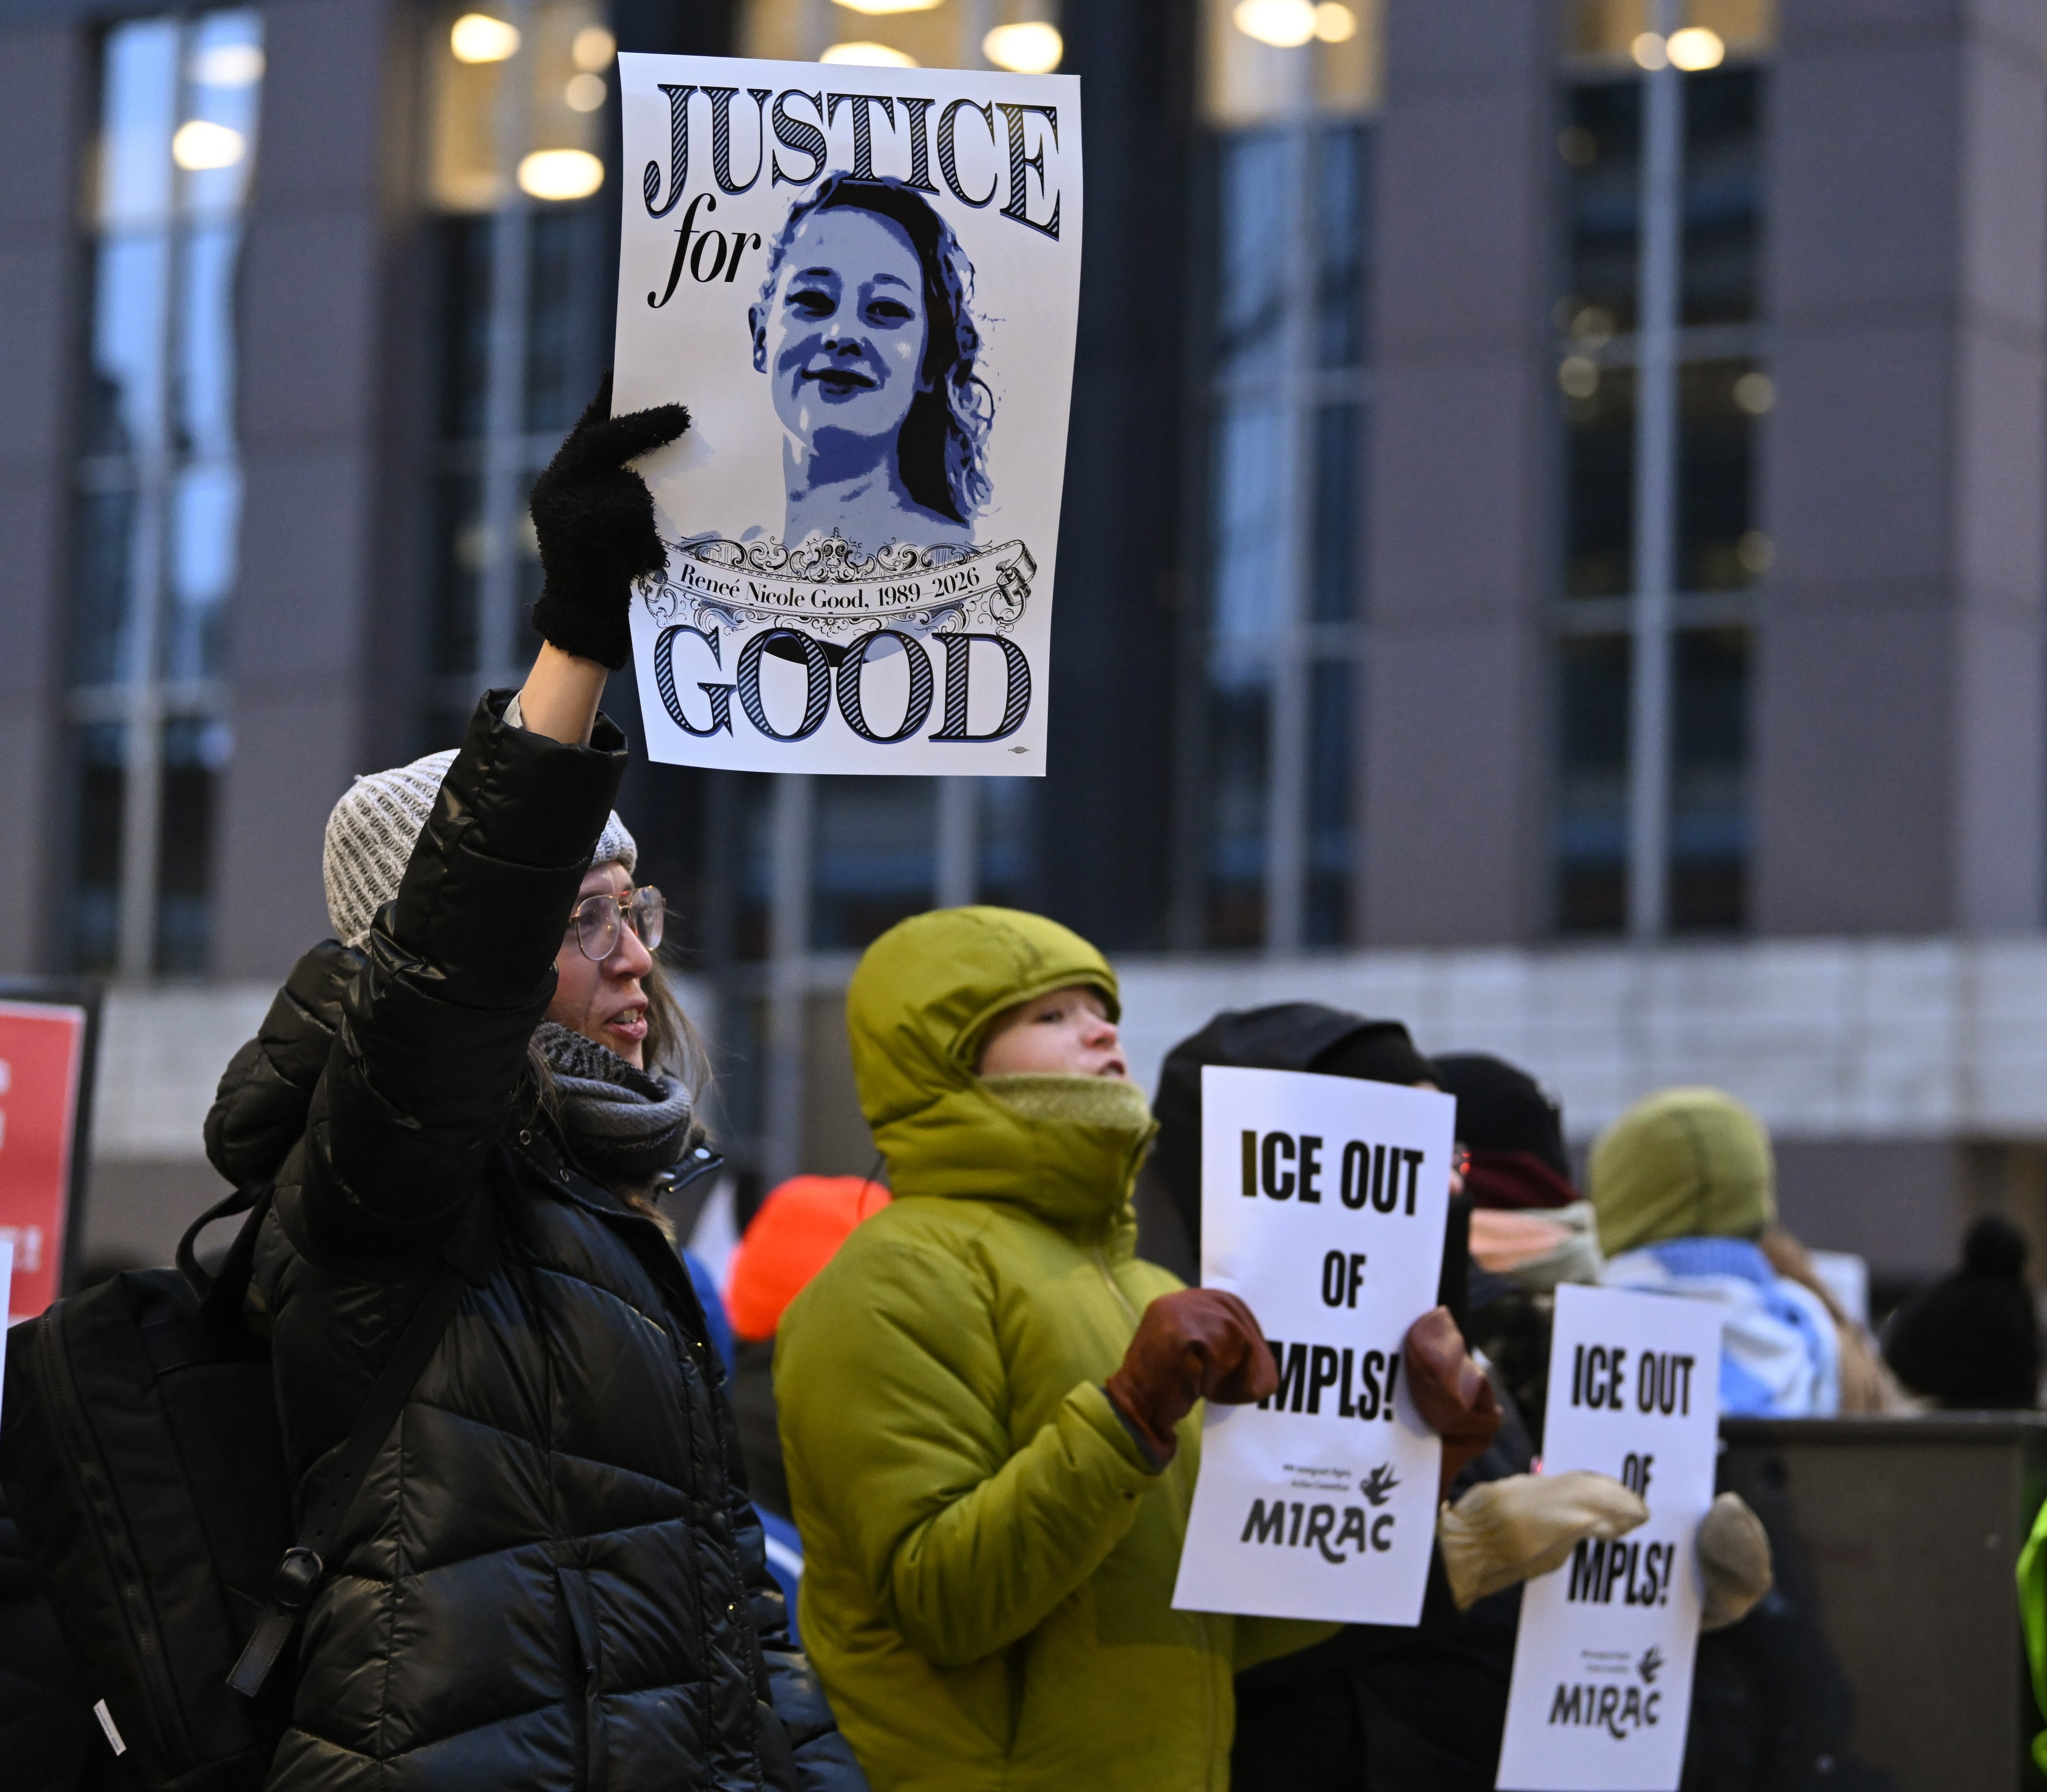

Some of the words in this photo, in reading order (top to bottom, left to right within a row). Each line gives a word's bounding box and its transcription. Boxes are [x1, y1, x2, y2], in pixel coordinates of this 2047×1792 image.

[643, 84, 1060, 241] JUSTICE
[647, 193, 760, 309] for
[680, 563, 740, 598] Reneé
[745, 581, 804, 607] Nicole
[811, 589, 869, 611] Good,
[655, 625, 1032, 744] GOOD
[1241, 1130, 1323, 1204] ICE
[1340, 1139, 1424, 1216] OUT
[1322, 1249, 1366, 1309] OF
[1257, 1340, 1400, 1421] MPLS!
[1572, 1343, 1626, 1410] ICE
[1638, 1351, 1695, 1416] OUT
[1240, 1498, 1395, 1565] MIRAC
[1568, 1538, 1676, 1607] MPLS!
[1548, 1683, 1661, 1740] MIRAC
